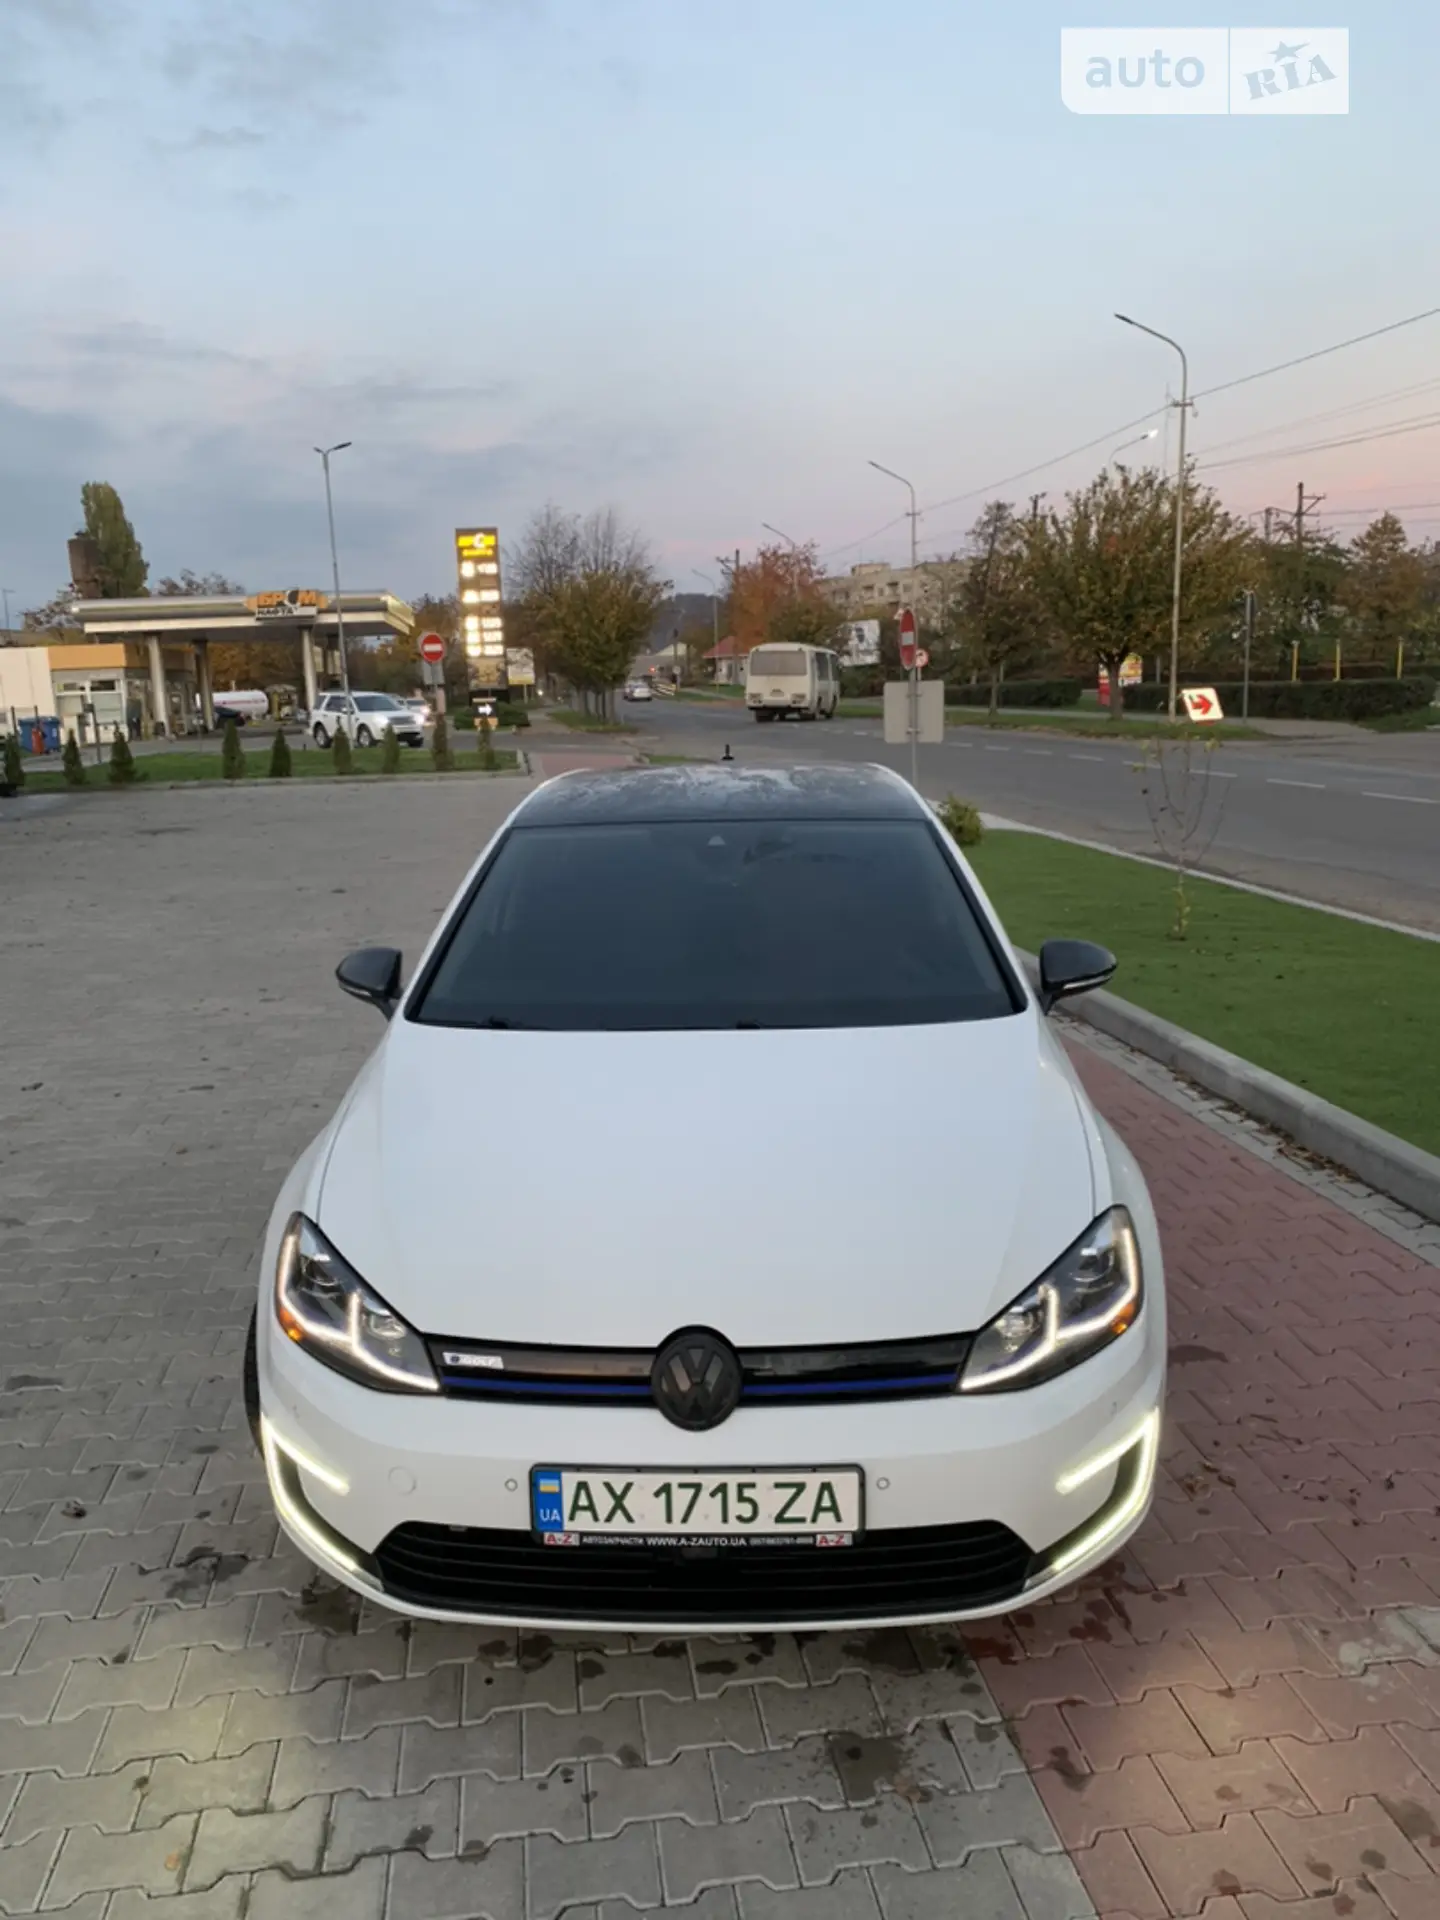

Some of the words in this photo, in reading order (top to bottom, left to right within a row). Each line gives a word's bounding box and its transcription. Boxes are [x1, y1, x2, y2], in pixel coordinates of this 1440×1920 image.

[568, 1481, 635, 1524] AX
[653, 1482, 759, 1524] 1715
[773, 1481, 843, 1524] ZA
[540, 1509, 561, 1523] UA
[646, 1536, 747, 1547] WWW.A-ZAUTO.UA
[818, 1534, 846, 1546] A-Z
